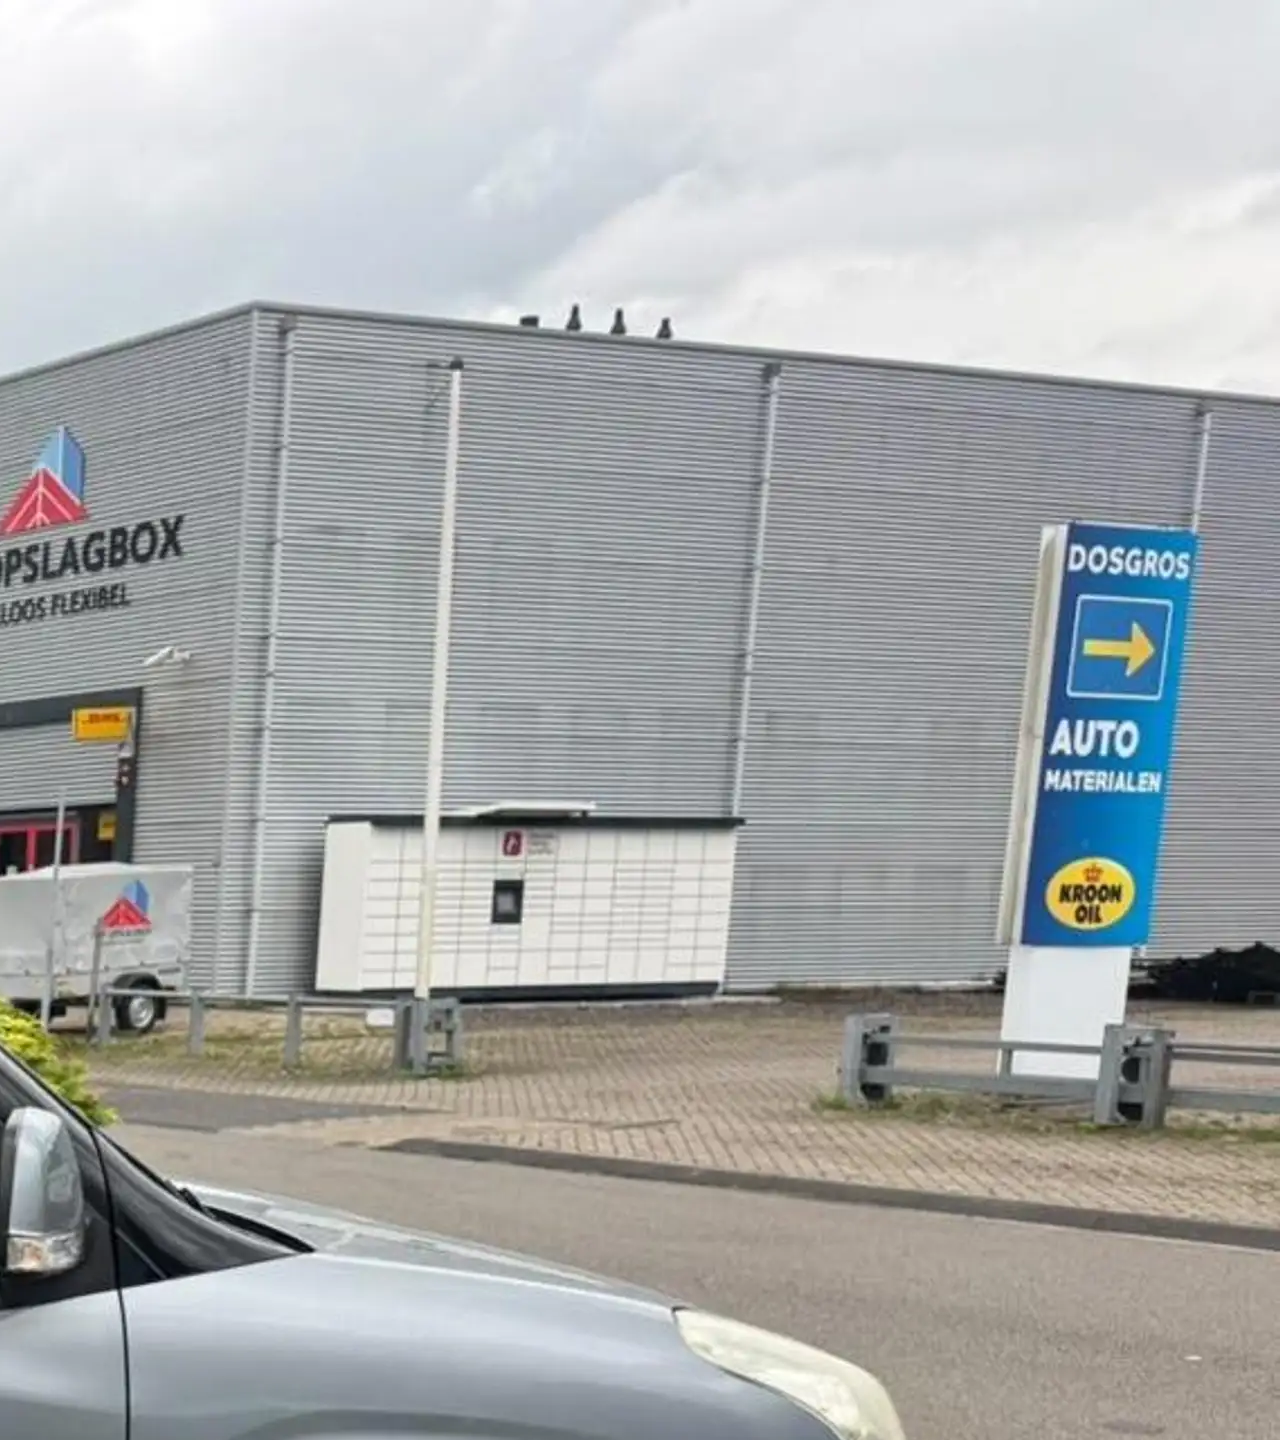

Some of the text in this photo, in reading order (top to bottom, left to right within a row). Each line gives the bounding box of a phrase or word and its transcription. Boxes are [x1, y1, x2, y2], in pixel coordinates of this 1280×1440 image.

[1067, 544, 1191, 580] DOSGROS
[49, 583, 131, 616] FLEXIBEL
[1050, 719, 1140, 759] AUTO
[1043, 769, 1162, 793] MATERIALEN
[1058, 882, 1123, 903] KROON
[1074, 904, 1102, 924] OIL
